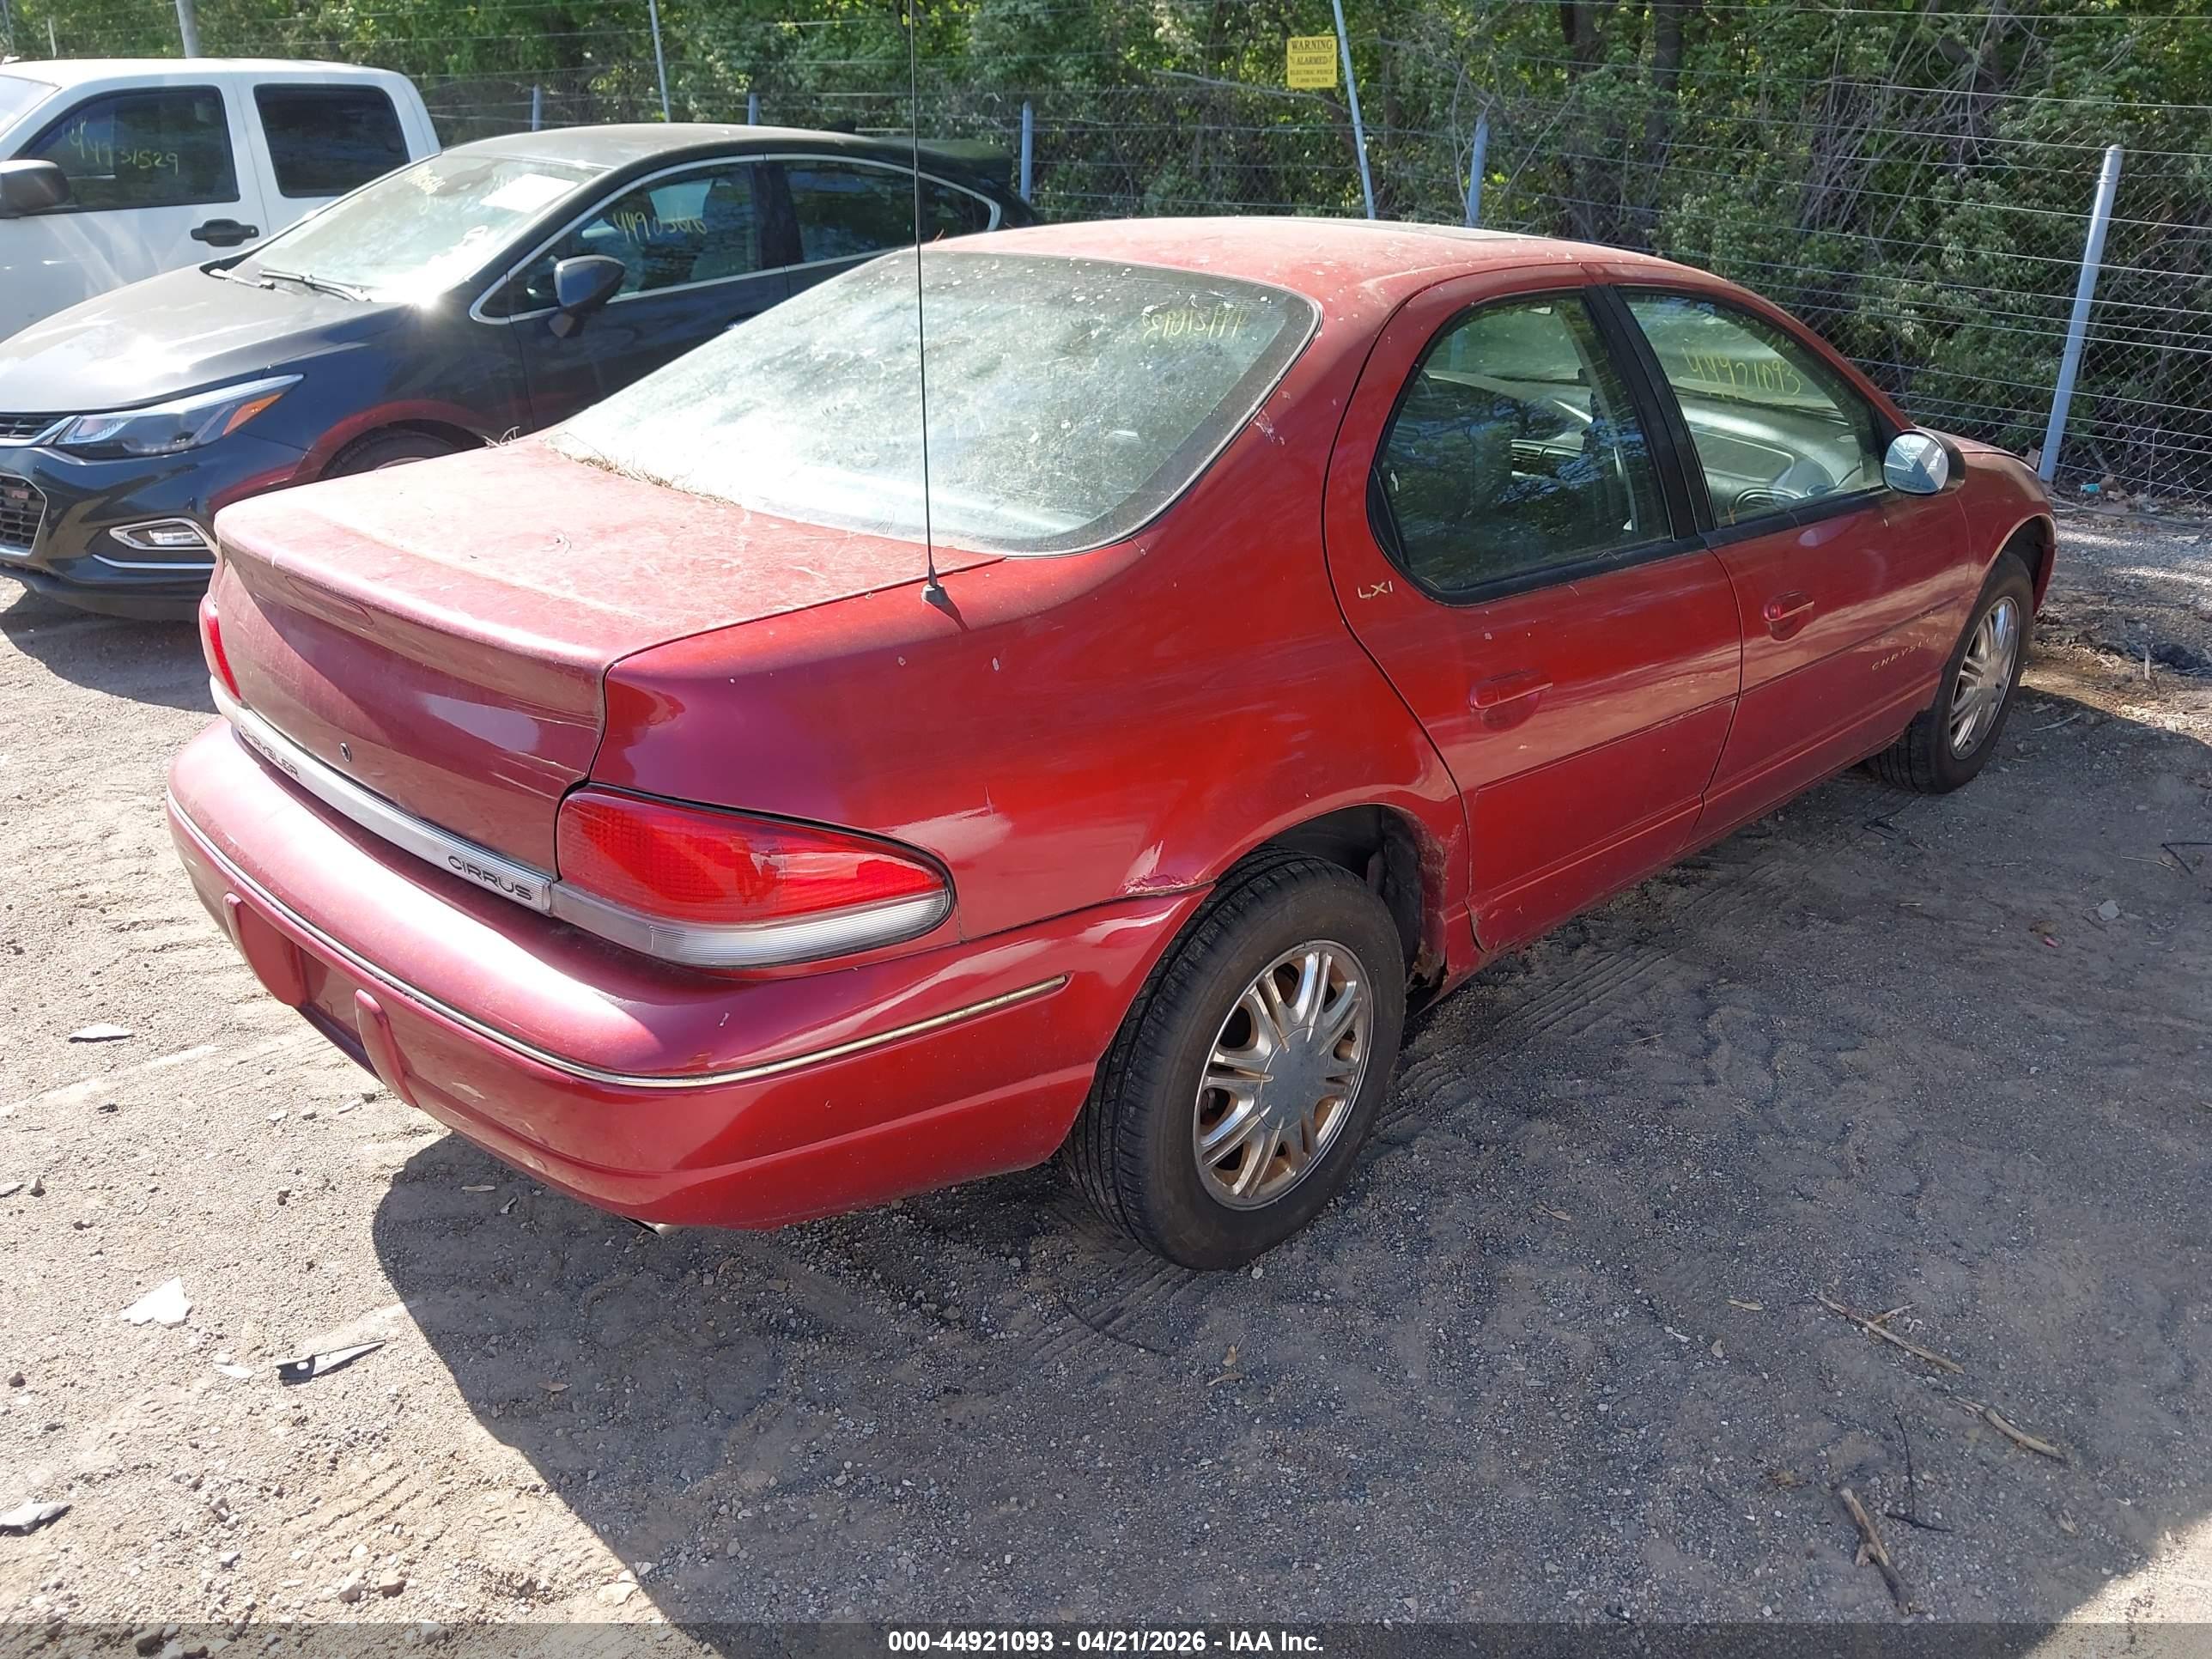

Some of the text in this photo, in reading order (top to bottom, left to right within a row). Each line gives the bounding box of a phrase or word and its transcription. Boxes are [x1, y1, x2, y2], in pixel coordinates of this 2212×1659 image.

[1291, 40, 1333, 51] WARNING
[1358, 580, 1393, 599] LXI
[447, 855, 532, 901] CIRRUS
